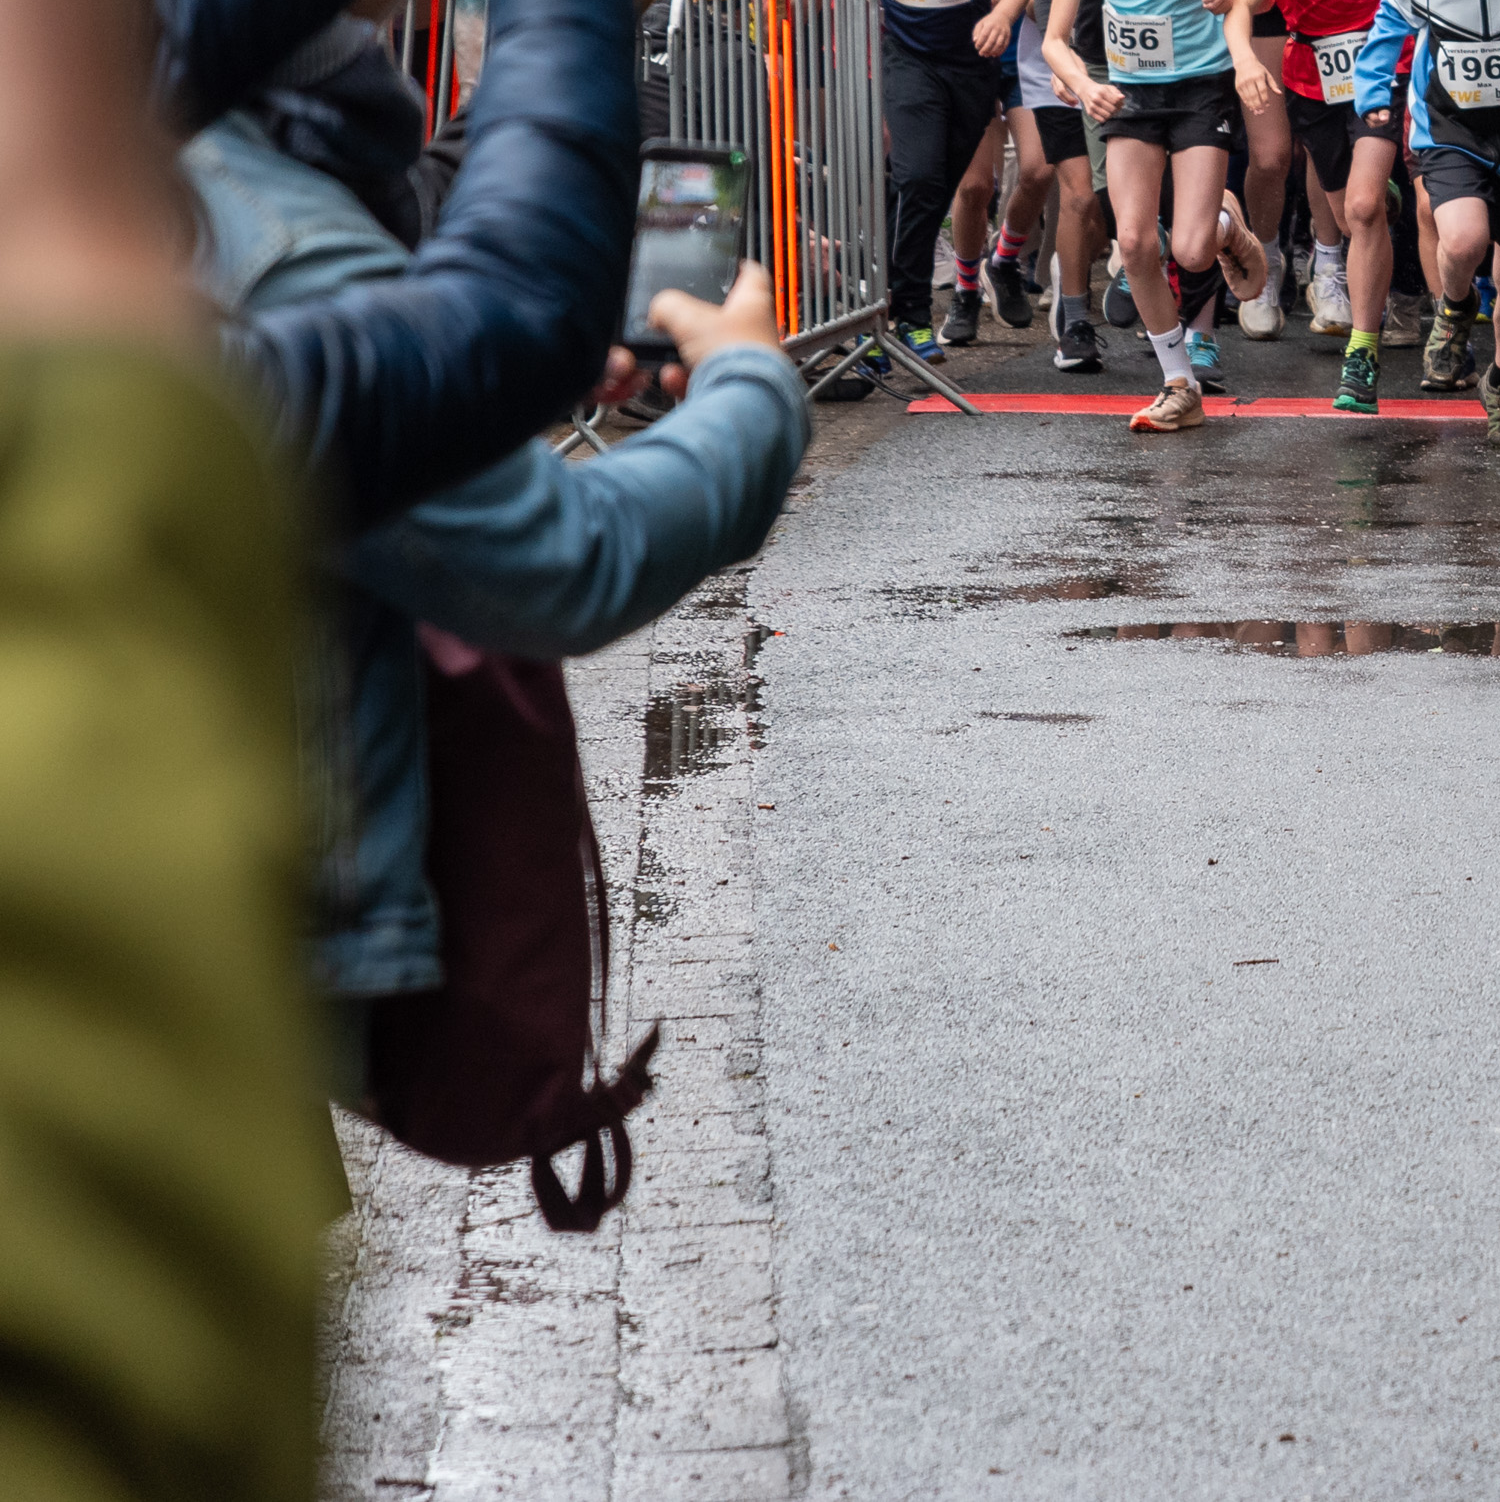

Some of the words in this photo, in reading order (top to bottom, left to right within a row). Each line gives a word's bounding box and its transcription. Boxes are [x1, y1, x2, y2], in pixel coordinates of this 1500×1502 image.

[1107, 20, 1160, 51] 656
[1137, 58, 1167, 68] bruns
[1329, 82, 1354, 98] EWE
[1449, 90, 1482, 103] EWE
